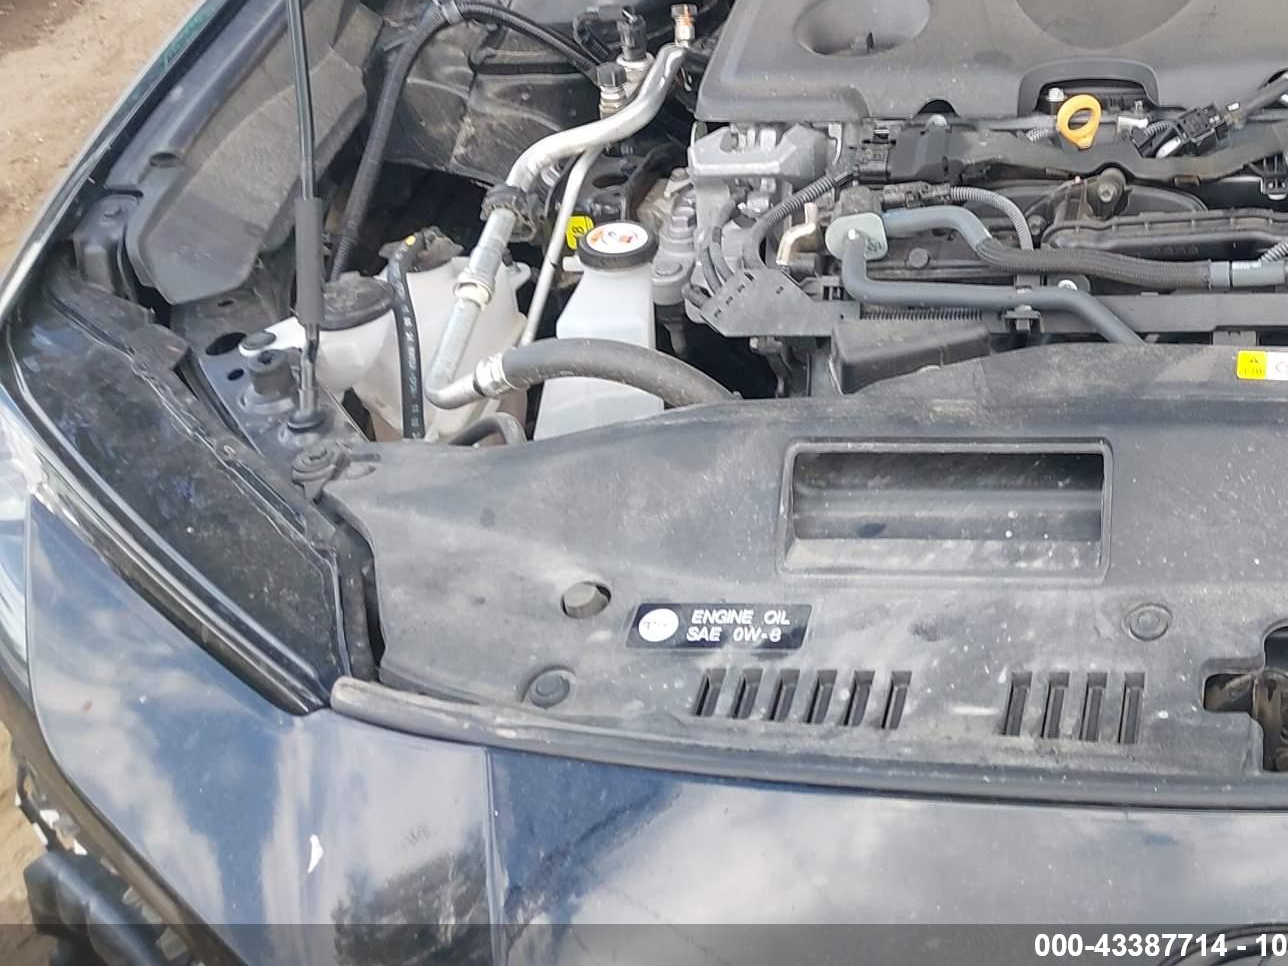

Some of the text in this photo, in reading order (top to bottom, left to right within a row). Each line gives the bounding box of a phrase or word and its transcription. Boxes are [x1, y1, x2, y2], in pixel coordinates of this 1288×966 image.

[691, 609, 791, 626] ENGINE OIL
[686, 625, 723, 642] SAE
